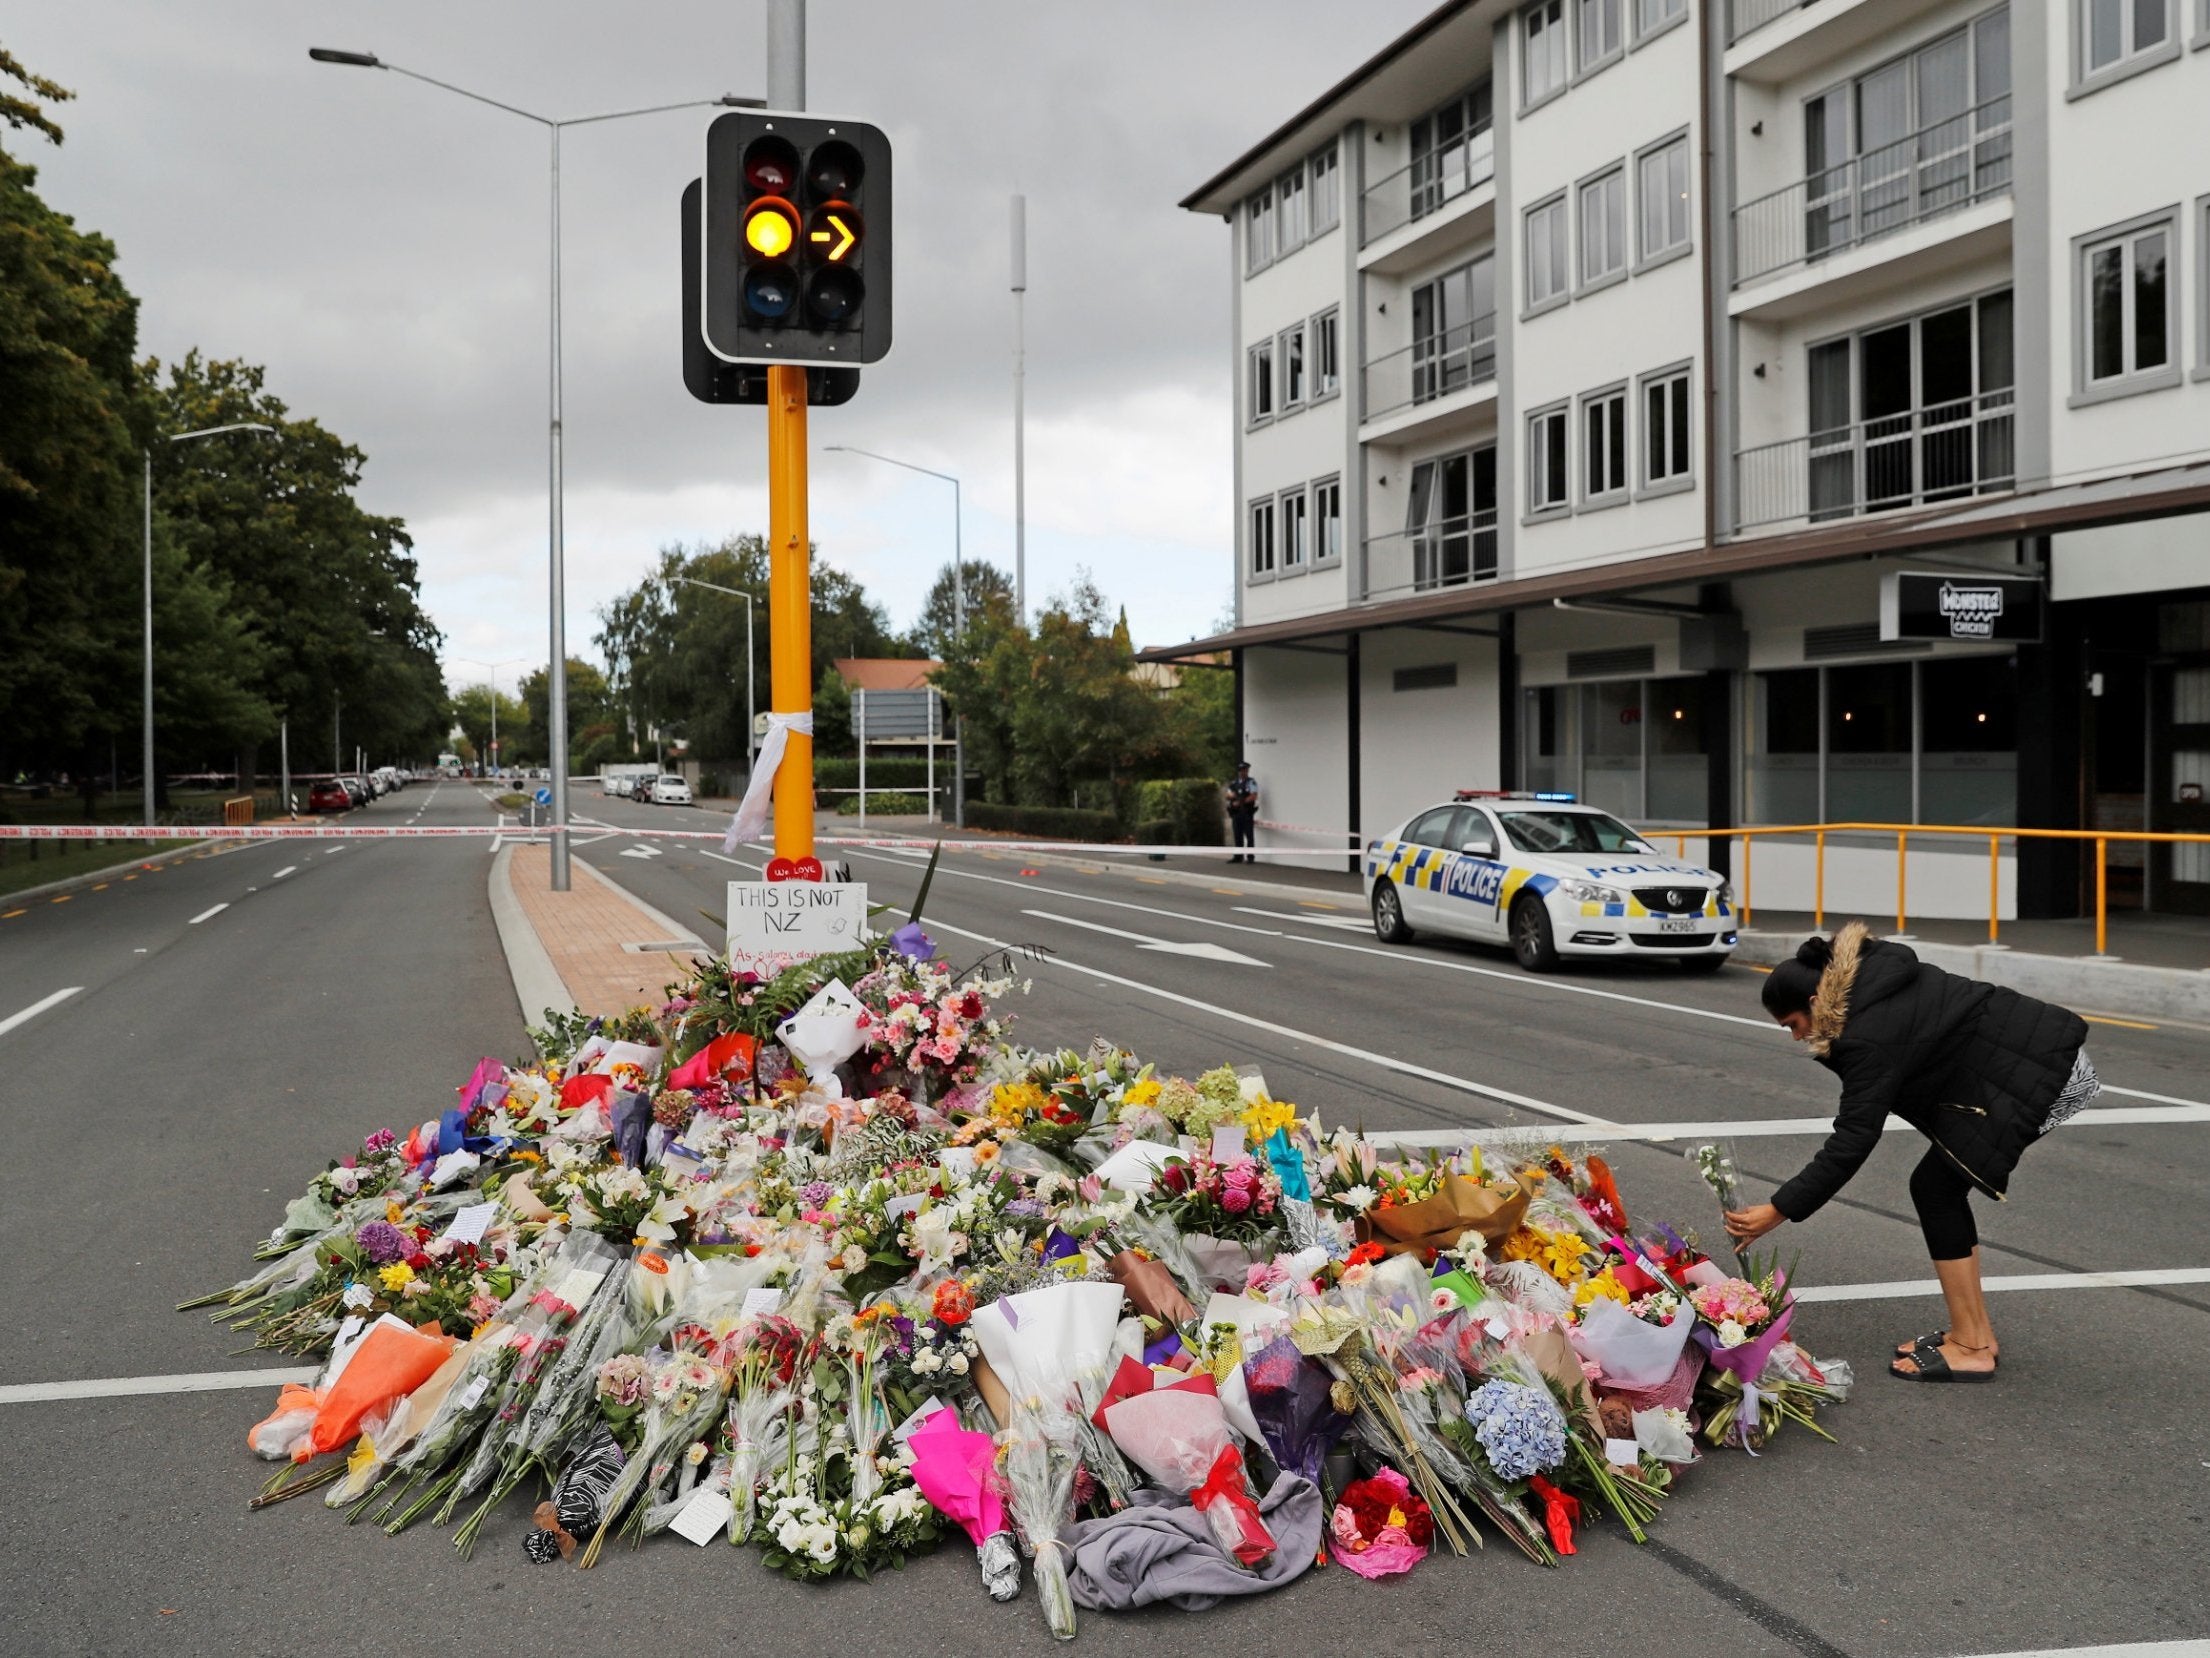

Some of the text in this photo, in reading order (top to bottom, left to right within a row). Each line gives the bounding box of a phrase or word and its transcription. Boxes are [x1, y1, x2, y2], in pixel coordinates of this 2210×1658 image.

[1943, 592, 1999, 611] MONSTER
[29, 827, 51, 836] POLICE
[57, 828, 96, 836] EMERGENCY
[104, 828, 127, 836] POLICE
[132, 828, 171, 837] EMERGENCY
[177, 828, 200, 837] POLICE
[205, 828, 244, 836] EMERGENCY
[774, 865, 816, 876] We LOVE
[1585, 864, 1716, 879] POLICE
[1450, 861, 1502, 899] POLICE
[737, 887, 779, 908] THIS
[788, 888, 805, 907] IS
[809, 889, 845, 908] NOT
[764, 911, 802, 934] NZ
